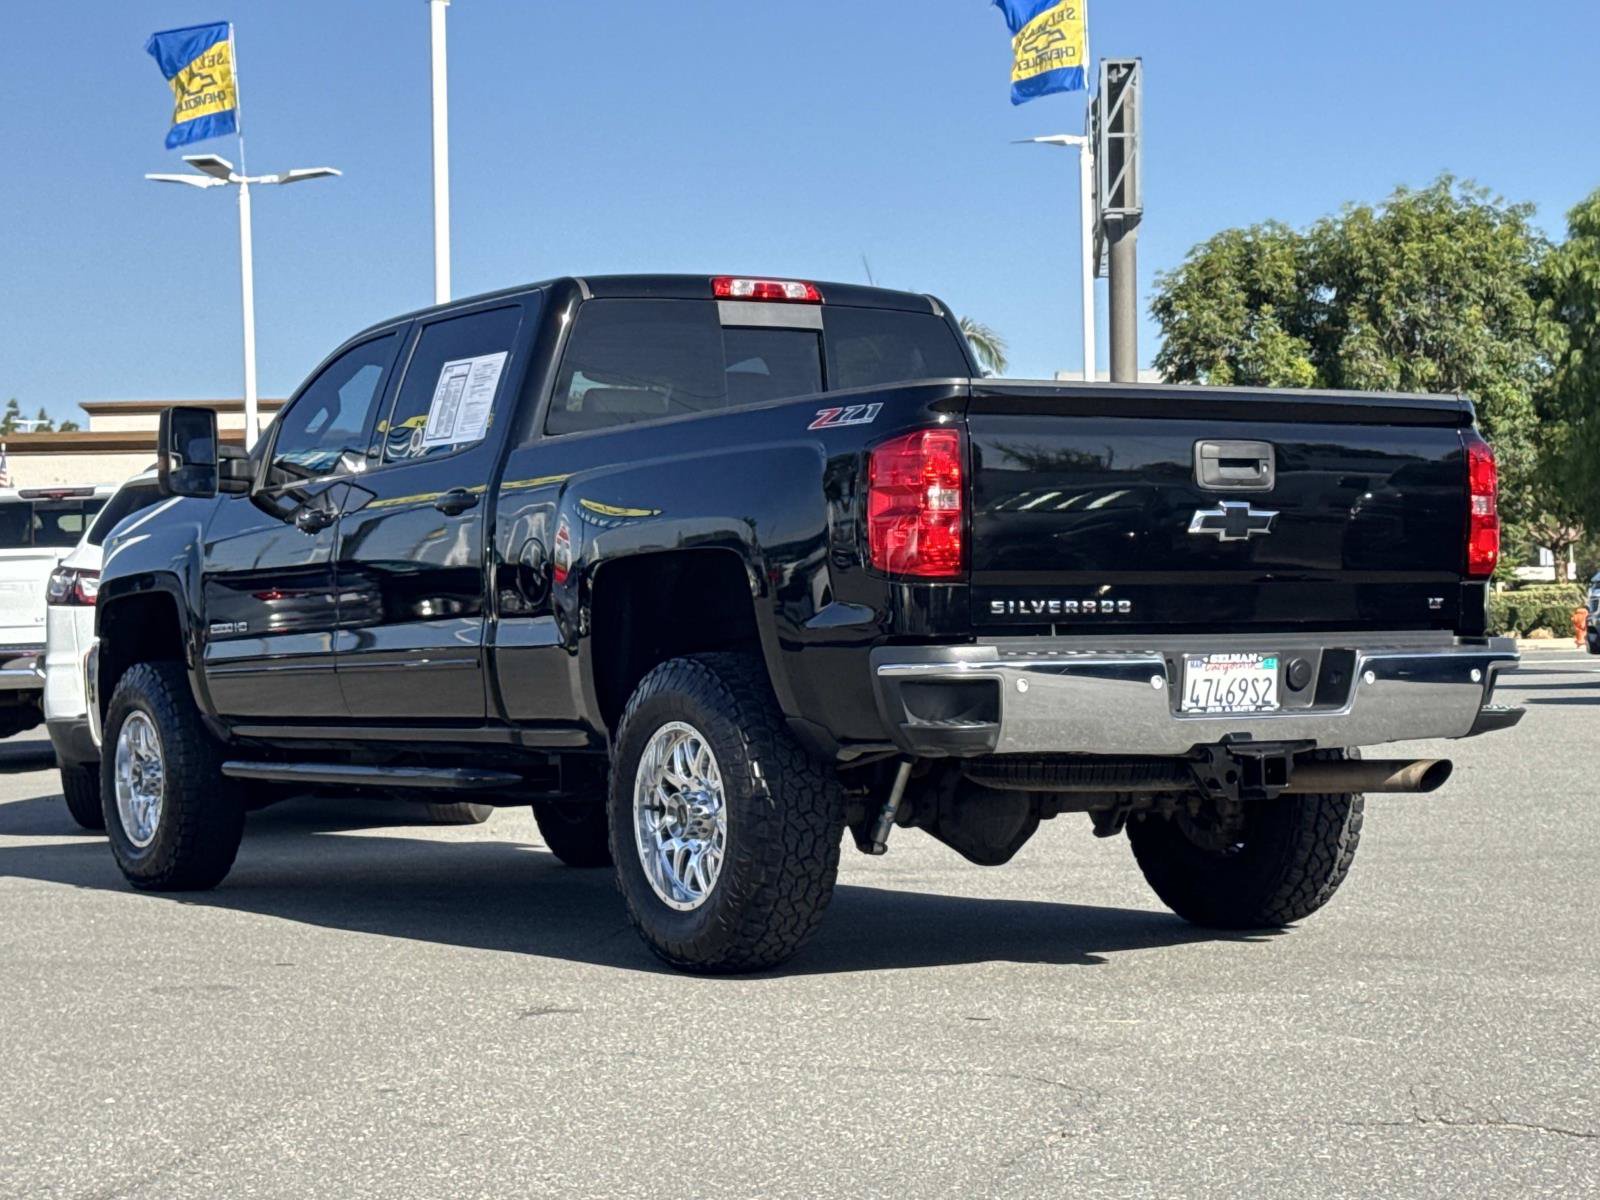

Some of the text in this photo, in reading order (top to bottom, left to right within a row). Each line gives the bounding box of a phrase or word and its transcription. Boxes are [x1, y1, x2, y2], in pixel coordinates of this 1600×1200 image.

[807, 402, 884, 430] Z71
[990, 600, 1132, 614] SILVERADO
[1427, 597, 1445, 609] LT
[1189, 677, 1273, 706] 47469S2
